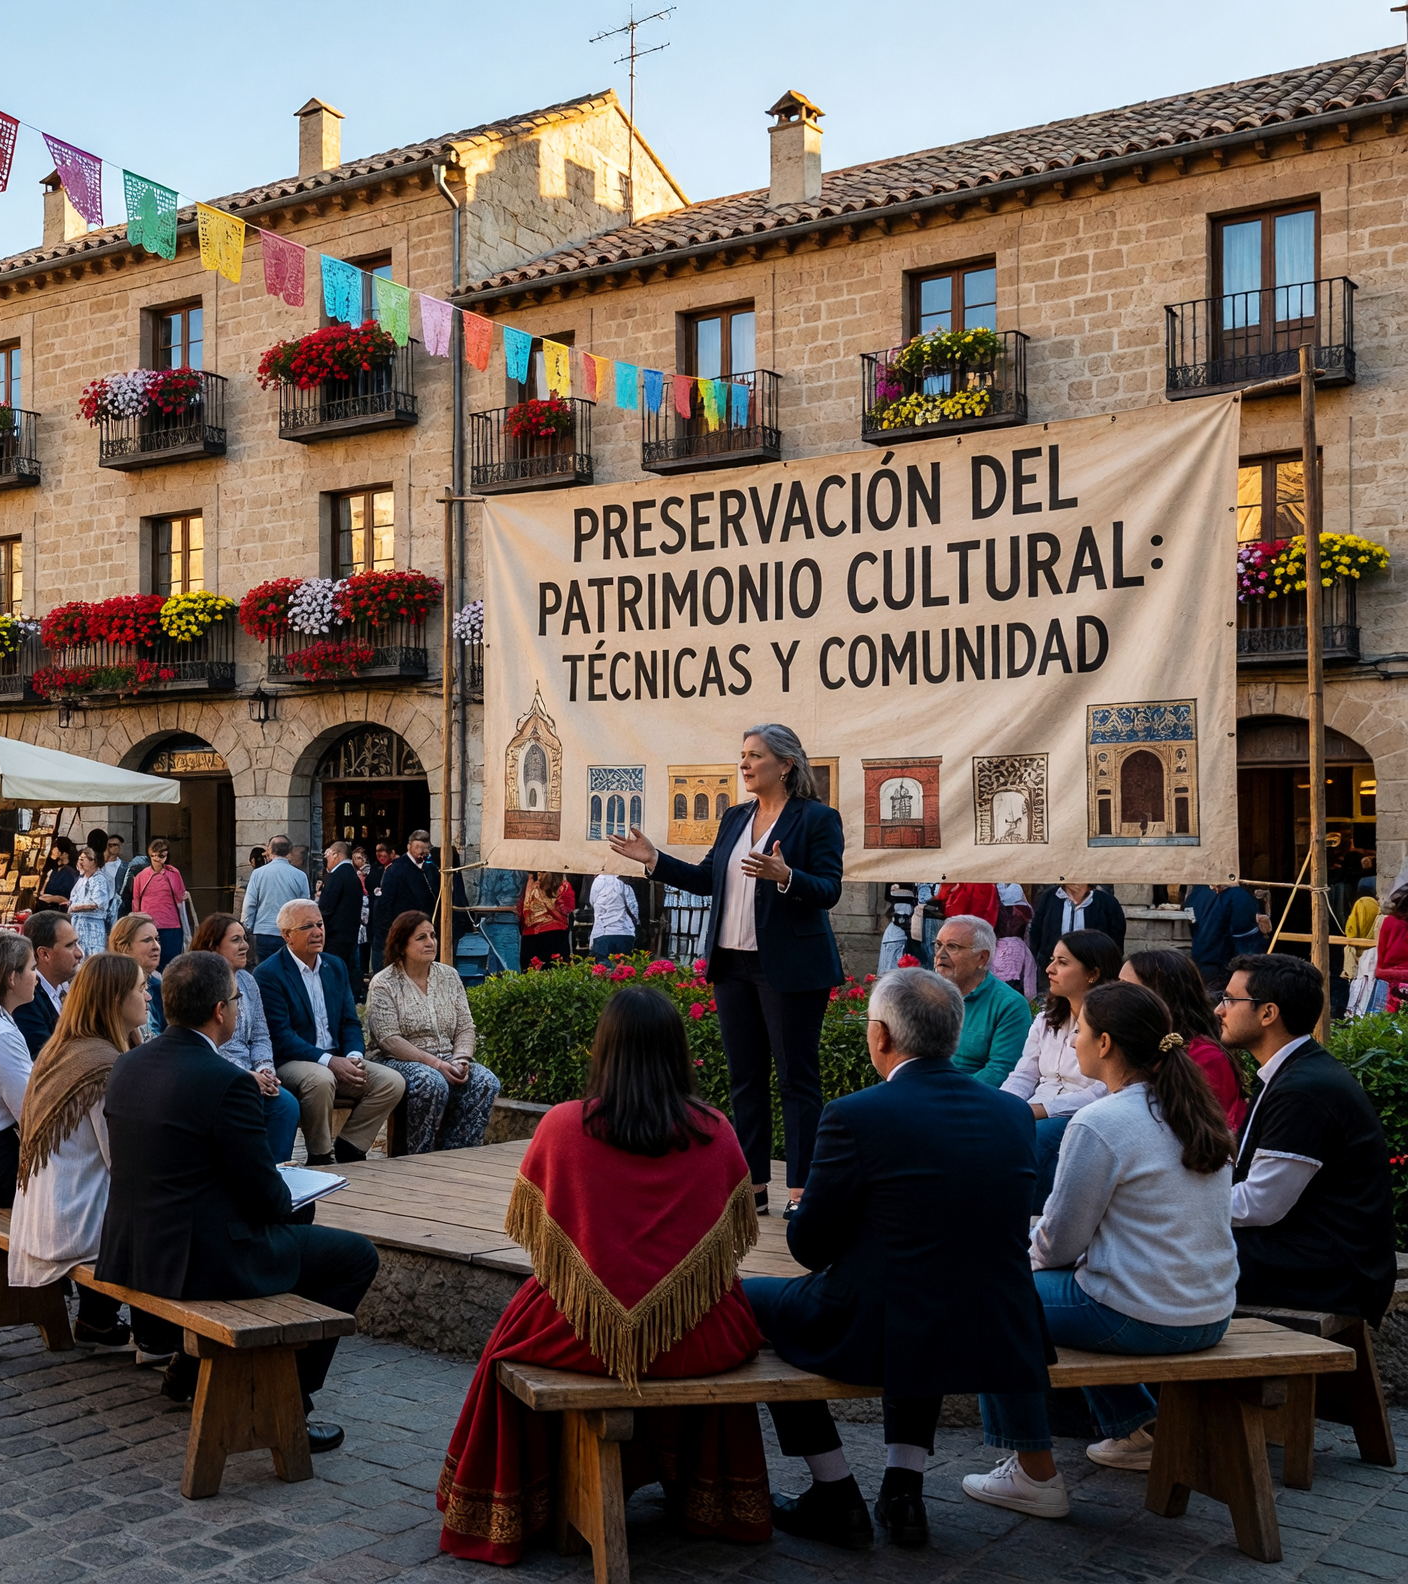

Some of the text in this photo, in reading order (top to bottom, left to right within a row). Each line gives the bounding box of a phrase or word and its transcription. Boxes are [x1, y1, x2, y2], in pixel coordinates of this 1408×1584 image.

[572, 443, 1078, 563] PRESERVACIÓN DEL
[538, 520, 1165, 637] PATRIMONIO CULTURAL:
[562, 614, 1110, 702] TÉCNICAS Y COMUNIDAD
